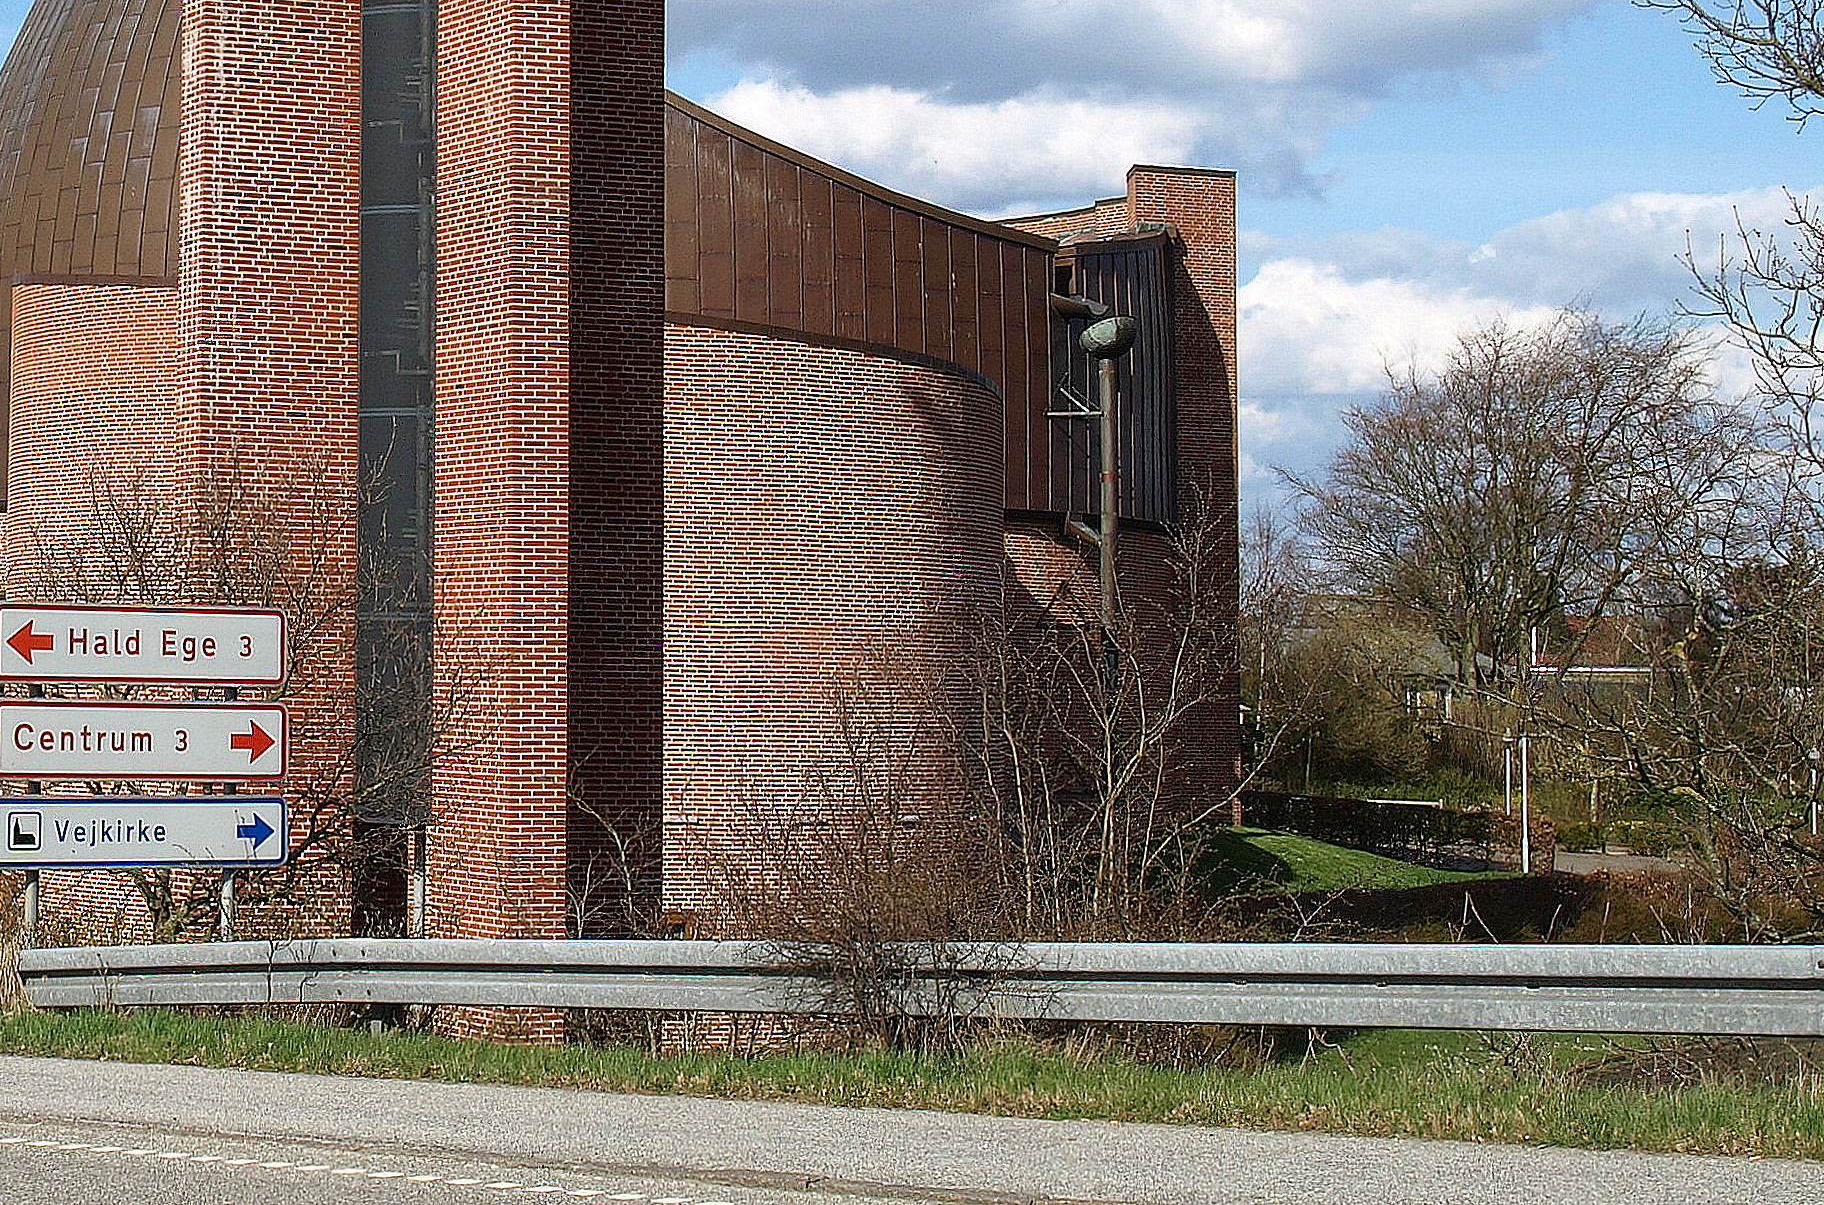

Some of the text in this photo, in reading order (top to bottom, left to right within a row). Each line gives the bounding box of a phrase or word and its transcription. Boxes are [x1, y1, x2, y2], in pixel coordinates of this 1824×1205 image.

[68, 628, 252, 662] Hald Ege 3
[13, 723, 189, 752] Centrum 3
[54, 819, 167, 847] Vejkirke
